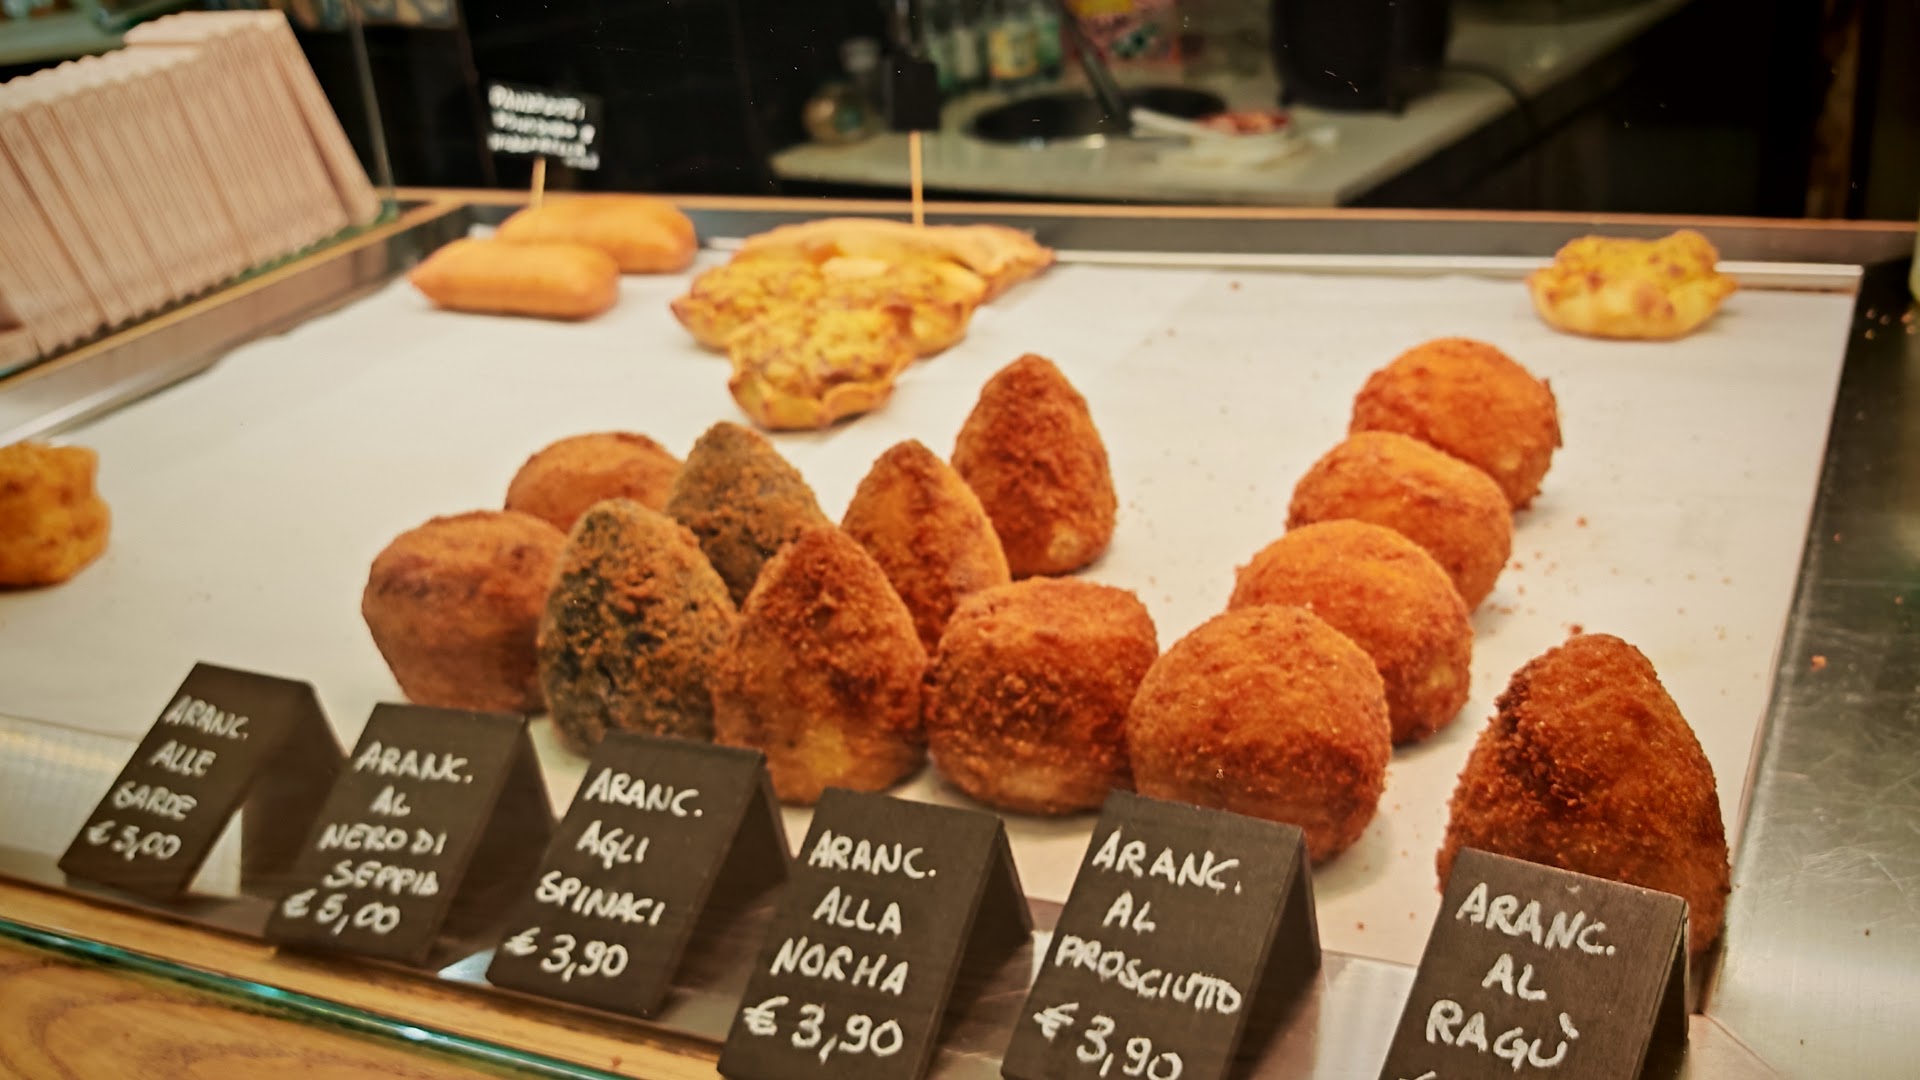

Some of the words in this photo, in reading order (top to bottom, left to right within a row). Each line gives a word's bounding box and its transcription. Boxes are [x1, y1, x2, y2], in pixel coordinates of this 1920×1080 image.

[164, 695, 249, 740] ARANC.
[149, 739, 217, 777] ALLE
[354, 741, 473, 784] ARANC.
[113, 781, 198, 821] SARDE
[370, 785, 411, 816] AL
[584, 767, 703, 817] ARANC.
[318, 823, 408, 851] NERO
[410, 828, 447, 855] DI
[575, 820, 650, 870] AGLI
[808, 829, 936, 879] ARANC.
[1092, 828, 1242, 894] ARANC.
[323, 859, 439, 896] SEPPIA
[535, 870, 665, 926] SPINACI
[283, 888, 318, 918] €
[316, 894, 401, 936] 5,00
[812, 886, 902, 936] ALLA
[1102, 890, 1156, 935] AL
[1455, 882, 1616, 955] ARANC.
[504, 927, 541, 956] €
[540, 934, 629, 982] 3,90
[1054, 934, 1242, 1014] PROSCIUTTO
[1481, 953, 1548, 1001] AL
[743, 996, 790, 1036] €
[791, 1003, 904, 1064] 3,90
[1033, 1002, 1080, 1041] €
[1076, 1014, 1184, 1080] 3,90
